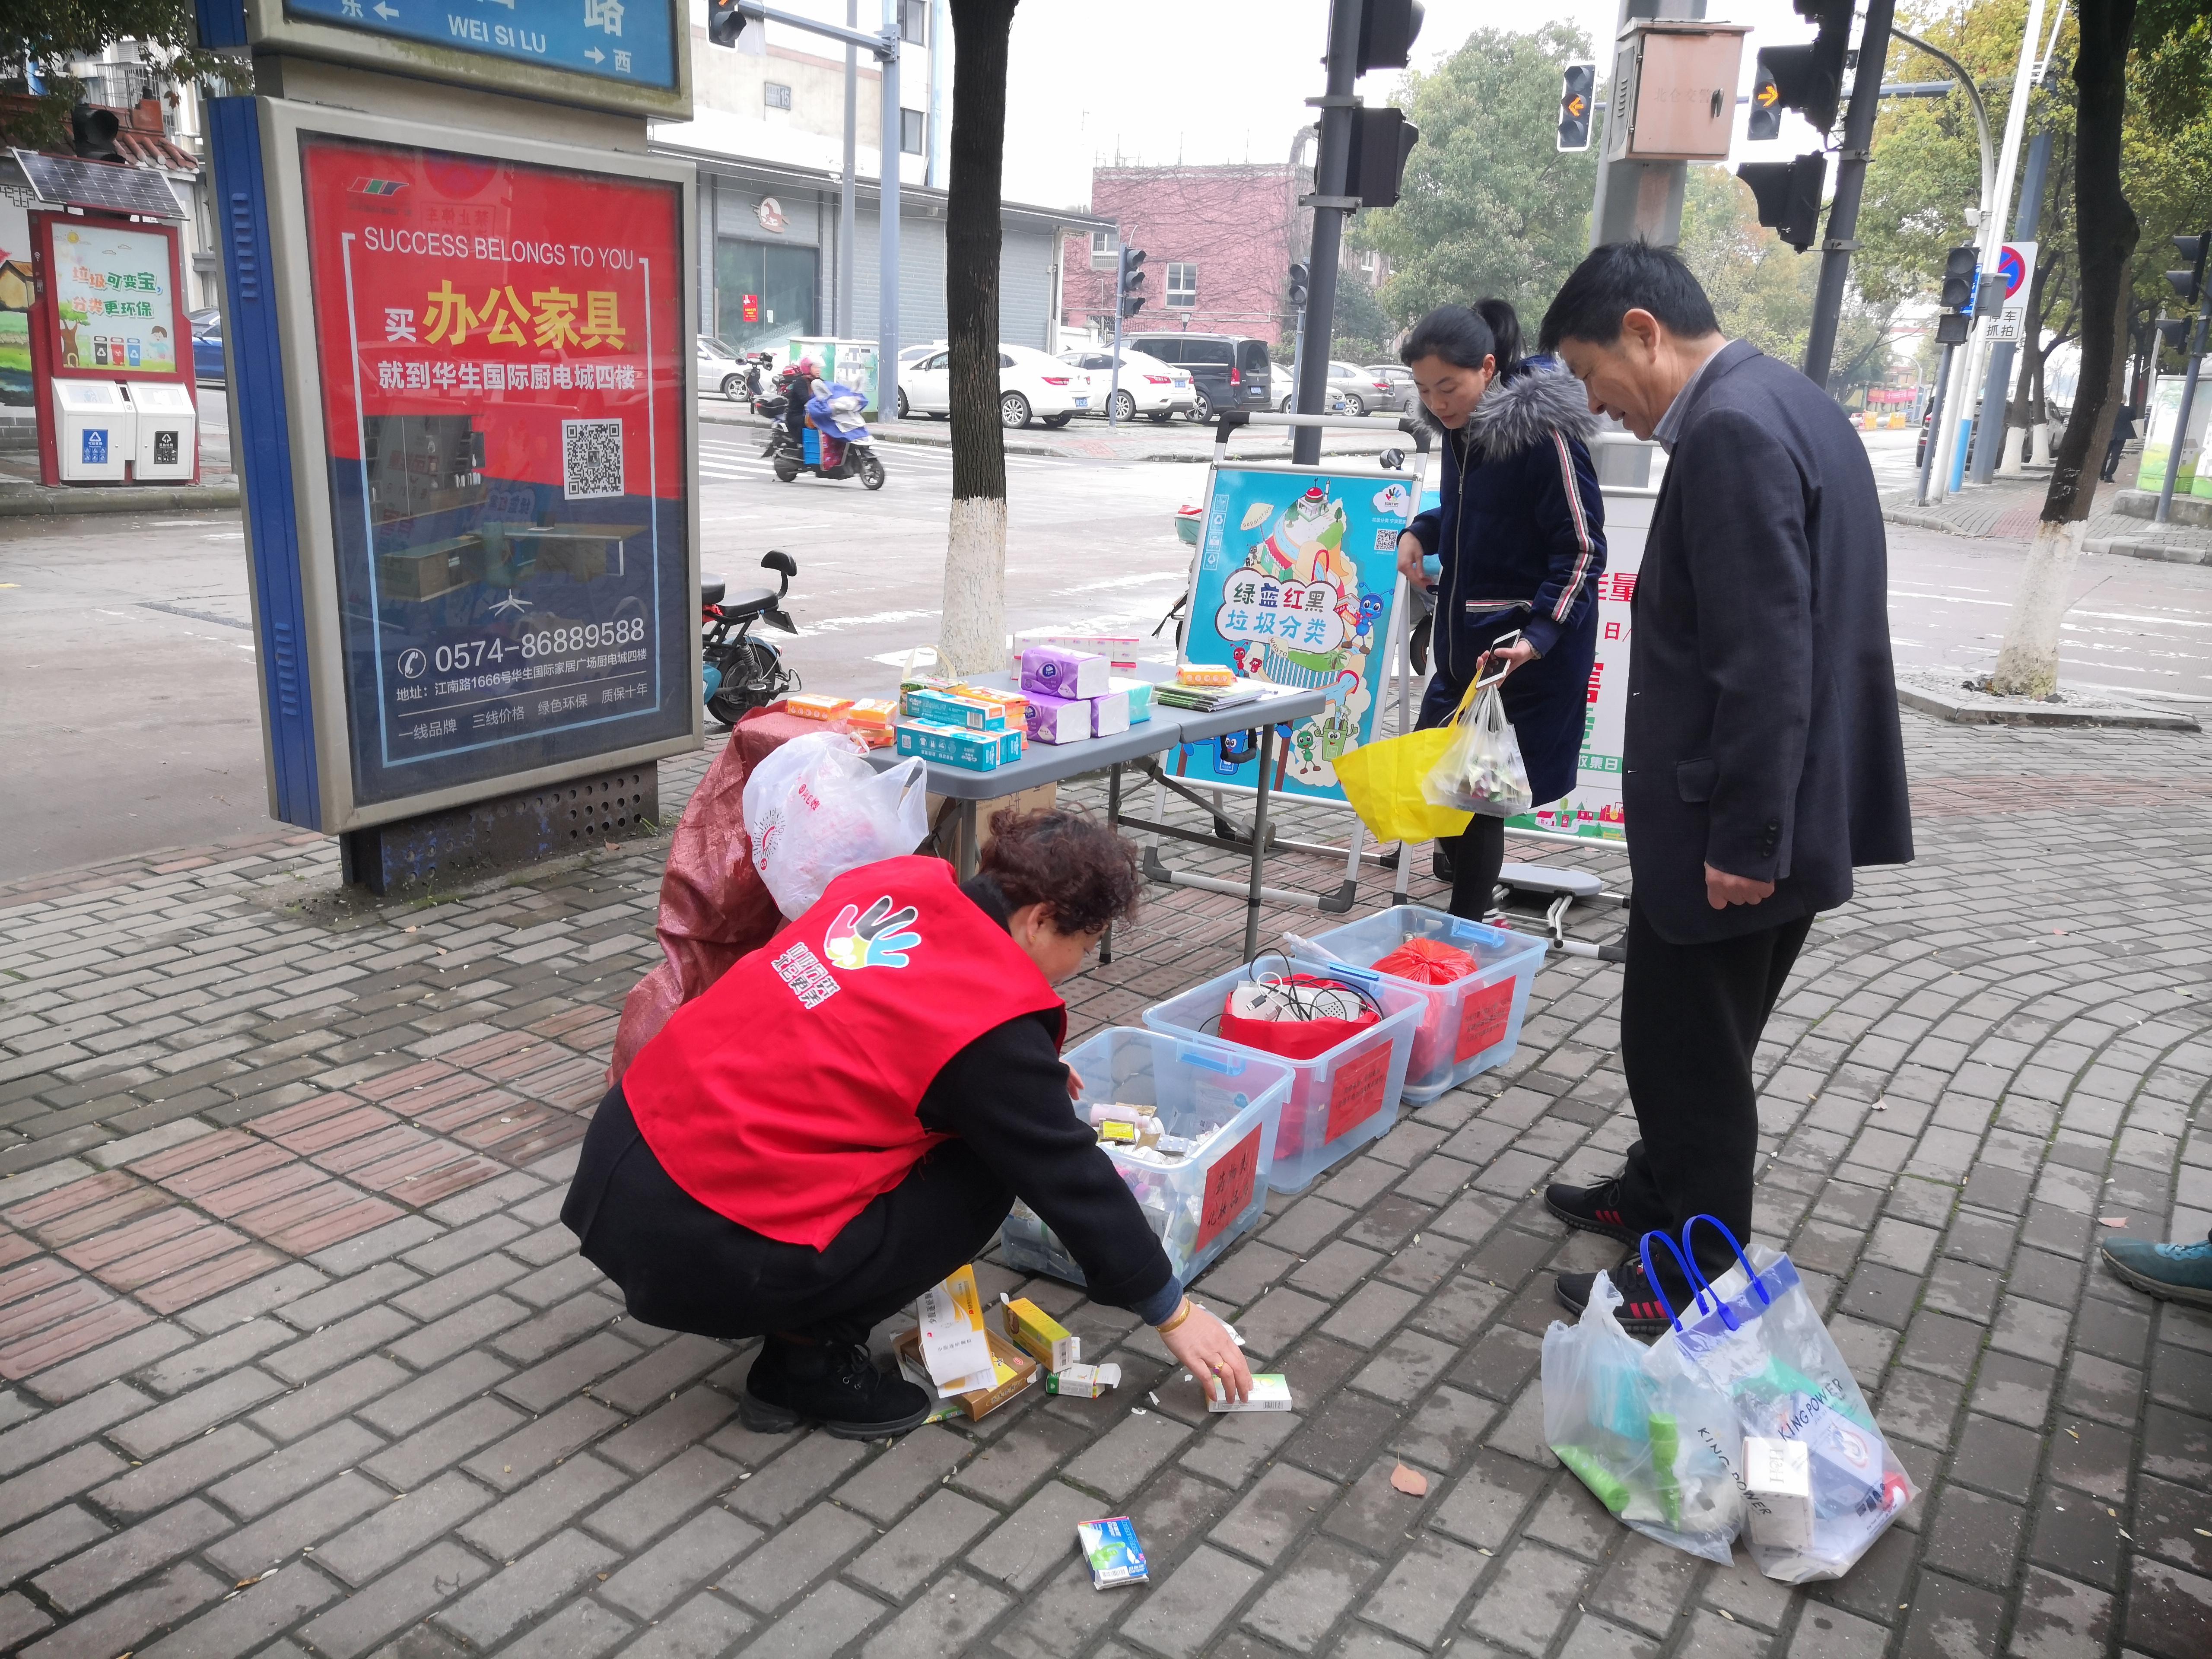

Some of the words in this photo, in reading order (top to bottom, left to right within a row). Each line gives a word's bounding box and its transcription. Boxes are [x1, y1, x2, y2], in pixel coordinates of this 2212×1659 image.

[448, 14, 489, 41] WEI
[494, 25, 515, 47] SI
[520, 30, 547, 54] LU
[612, 48, 632, 74] 西
[365, 226, 469, 258] SUCCESS
[474, 237, 566, 265] BELONGS
[569, 245, 594, 268] TO
[598, 248, 633, 270] YOU
[73, 297, 155, 319] 分类更环保
[378, 360, 636, 390] 就到华生国际厨电城四楼
[1233, 582, 1325, 613] 绿蓝红黑
[435, 617, 645, 672] 0574-86889588
[1225, 609, 1326, 645] 垃圾分类
[398, 718, 458, 740] 一线品牌
[472, 706, 525, 729] 三线价格
[537, 693, 588, 716] 绿色环保
[601, 683, 648, 704] 质保十年
[786, 942, 841, 1000] 垃圾分类
